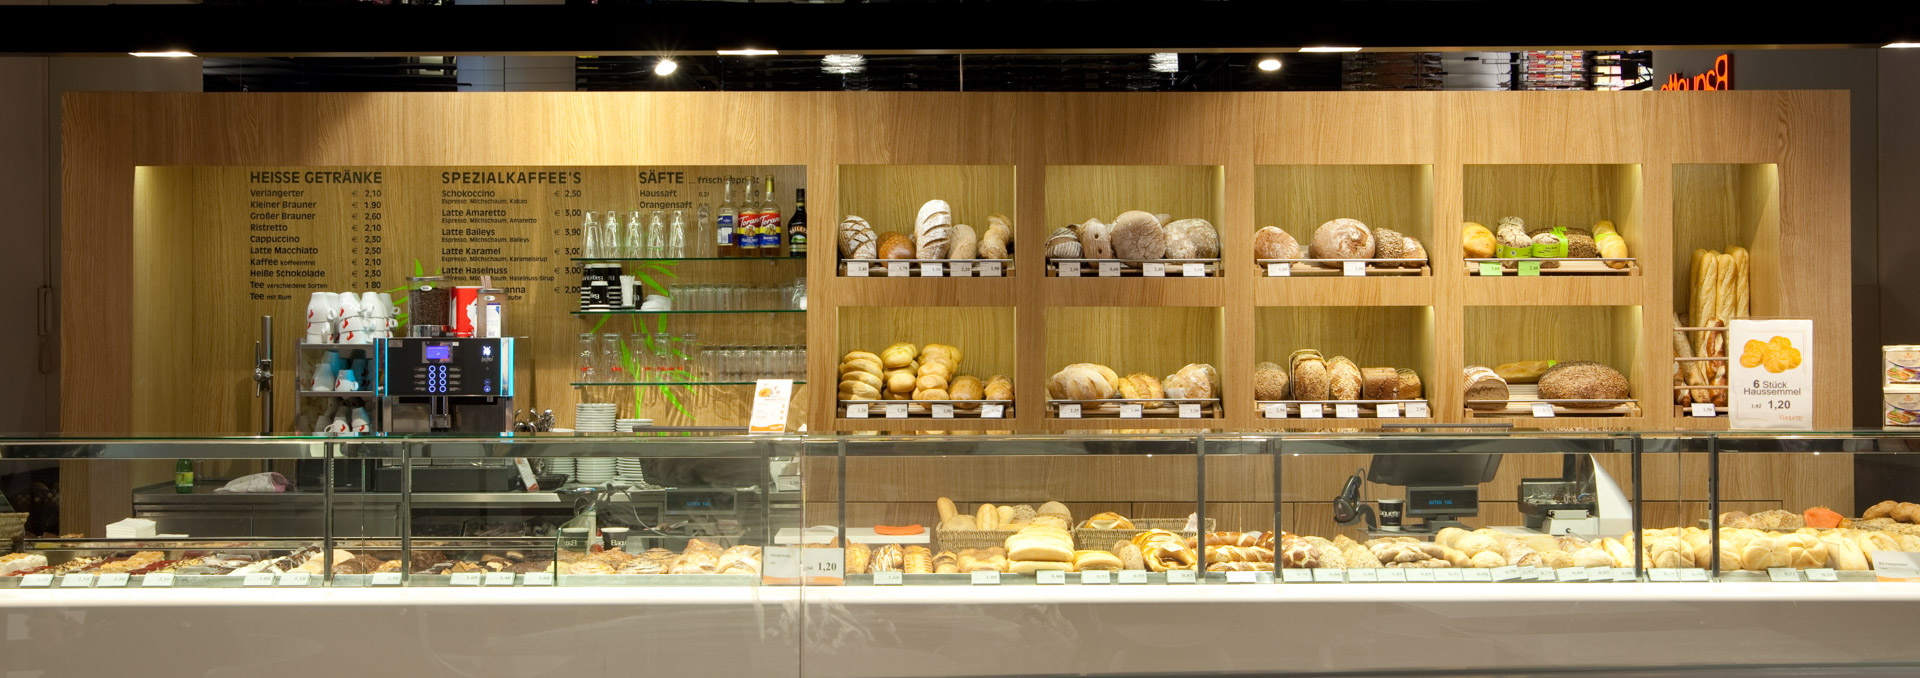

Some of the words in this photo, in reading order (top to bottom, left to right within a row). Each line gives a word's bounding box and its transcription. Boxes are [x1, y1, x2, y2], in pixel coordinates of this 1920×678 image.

[250, 172, 300, 184] HEISSE
[304, 170, 382, 184] GETRÄNKE
[441, 172, 582, 184] SPEZIALKAFFEE'S
[639, 171, 684, 184] SÄFTE
[698, 176, 722, 184] frisch
[364, 190, 382, 198] 2,10
[442, 190, 495, 198] Schokoccino
[564, 190, 582, 198] 2,50
[639, 189, 677, 197] Haussaft
[250, 201, 280, 209] Kleiner
[282, 201, 317, 209] Brauner
[363, 201, 382, 210] 1,90
[639, 201, 692, 209] Orangensaft
[250, 212, 279, 220] Großer
[281, 212, 316, 220] Brauner
[364, 213, 382, 221] 2,60
[442, 209, 463, 217] Latte
[466, 209, 506, 217] Amaretto
[564, 209, 582, 217] 3,00
[250, 224, 288, 232] Ristretto
[364, 224, 382, 233] 2,10
[442, 228, 463, 236] Latte
[466, 228, 495, 238] Baileys
[564, 228, 582, 236] 3,90
[250, 235, 300, 244] Cappuccino
[364, 236, 382, 244] 2,30
[364, 247, 382, 255] 2,50
[250, 258, 278, 266] Kaffee
[364, 259, 382, 267] 2,10
[364, 270, 382, 278] 2,30
[442, 267, 463, 275] Latte
[466, 267, 508, 275] Haselnuss
[564, 267, 582, 275] 3,00
[250, 292, 264, 300] Tee
[1753, 380, 1760, 388] 6
[1762, 380, 1787, 389] Stück
[1743, 388, 1801, 396] Haussemmel
[1768, 400, 1791, 410] 1,20
[818, 562, 837, 572] 1,20
